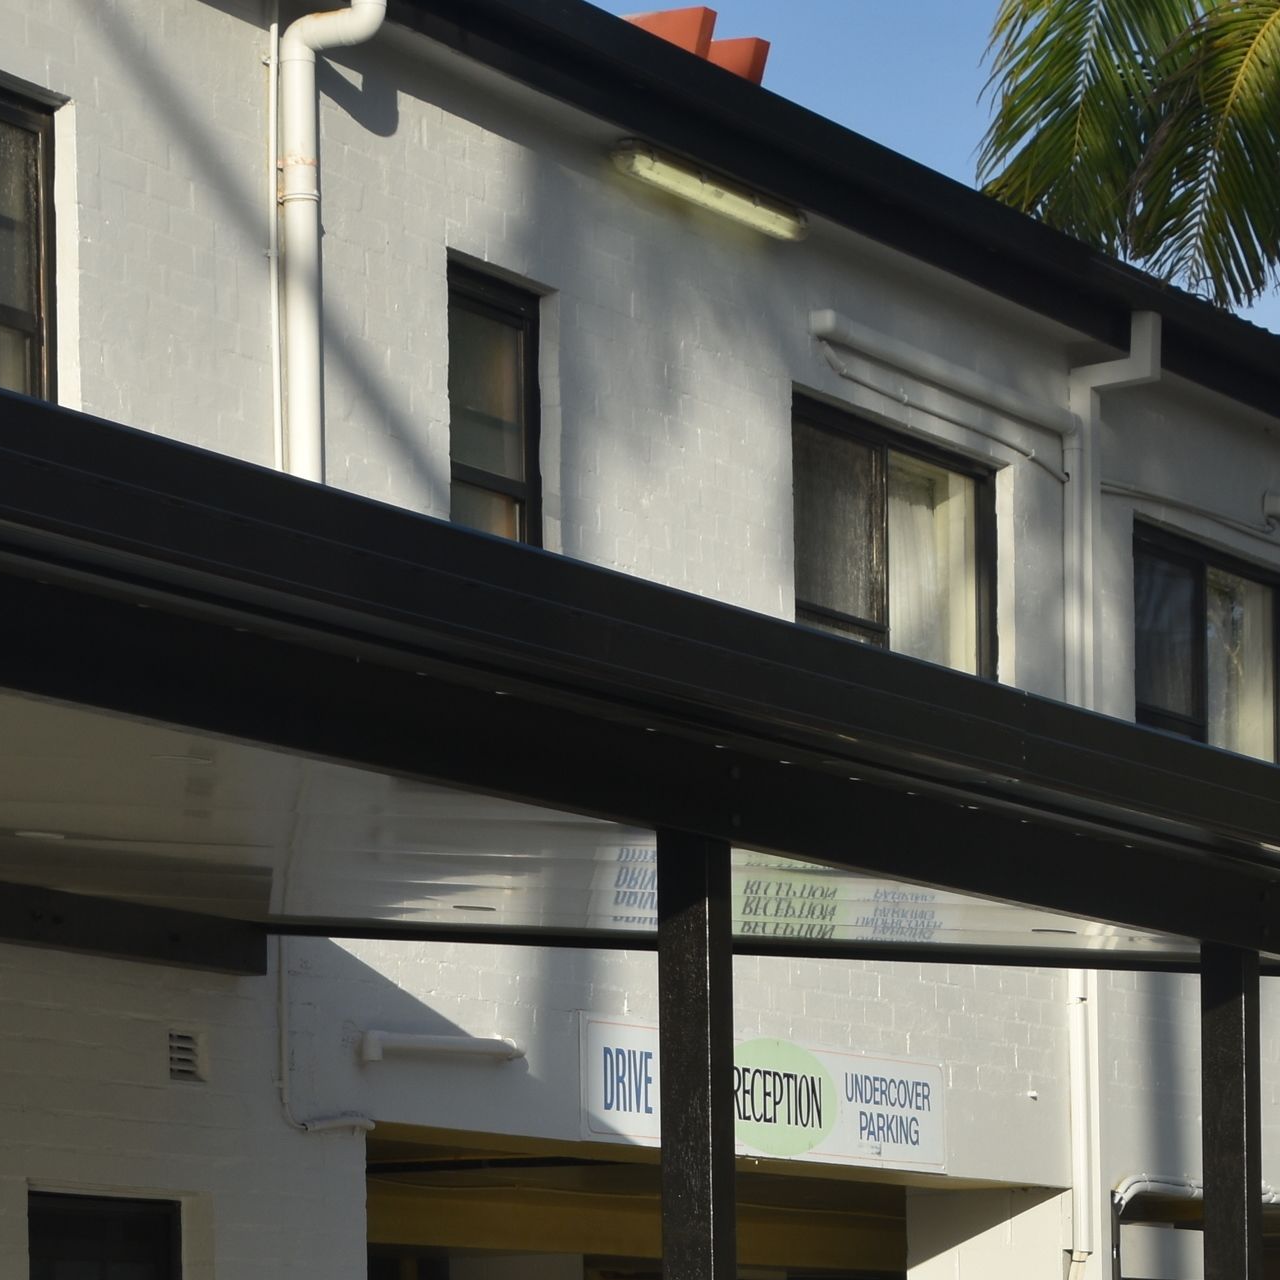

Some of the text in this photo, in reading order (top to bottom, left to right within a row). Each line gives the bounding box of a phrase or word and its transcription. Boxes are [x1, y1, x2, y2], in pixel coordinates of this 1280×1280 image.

[603, 1046, 653, 1114] DRIVE
[734, 1066, 822, 1129] RECEPTION
[845, 1072, 931, 1112] UNDERCOVER
[859, 1111, 920, 1146] PARKING
